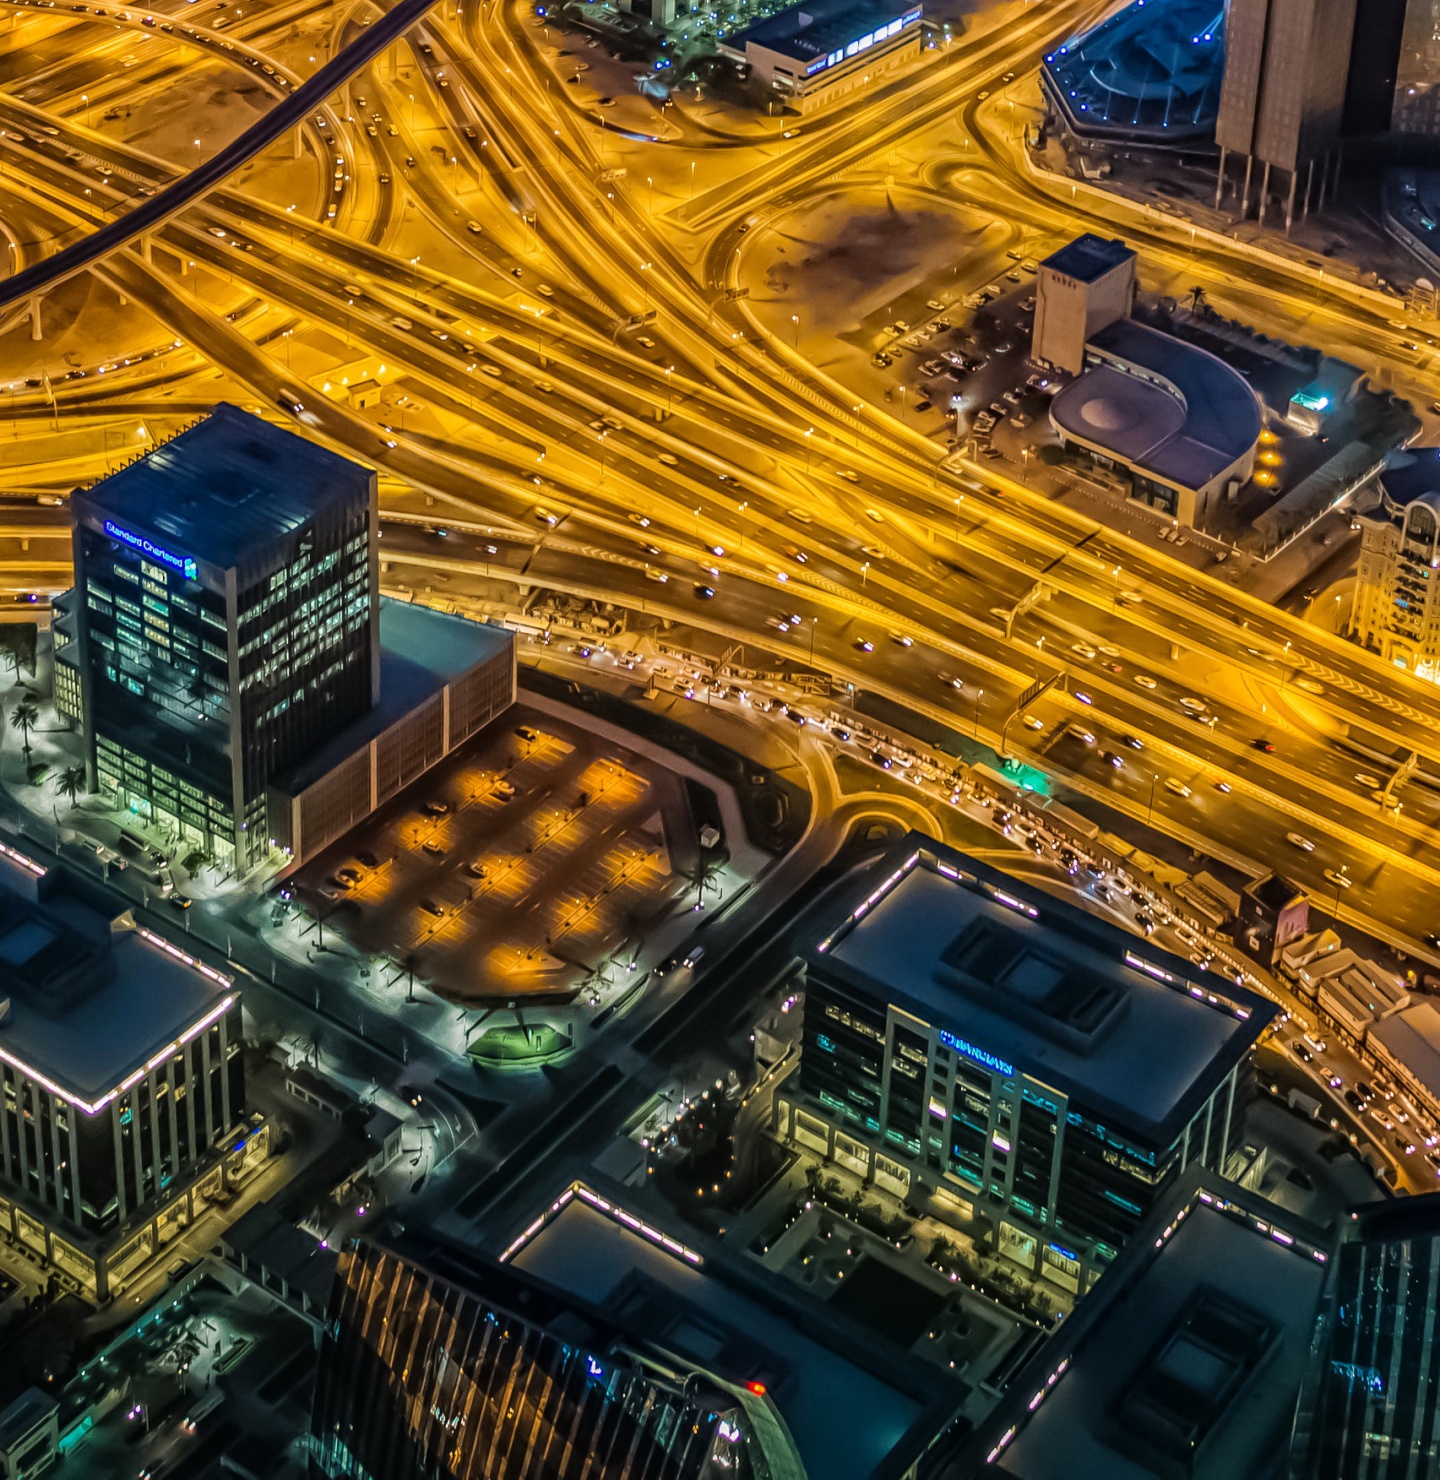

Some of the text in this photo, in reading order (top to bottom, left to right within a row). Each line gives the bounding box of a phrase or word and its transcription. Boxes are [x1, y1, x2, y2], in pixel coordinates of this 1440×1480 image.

[106, 522, 183, 567] Standard Chartered
[955, 1039, 1013, 1075] BARCLAYS
